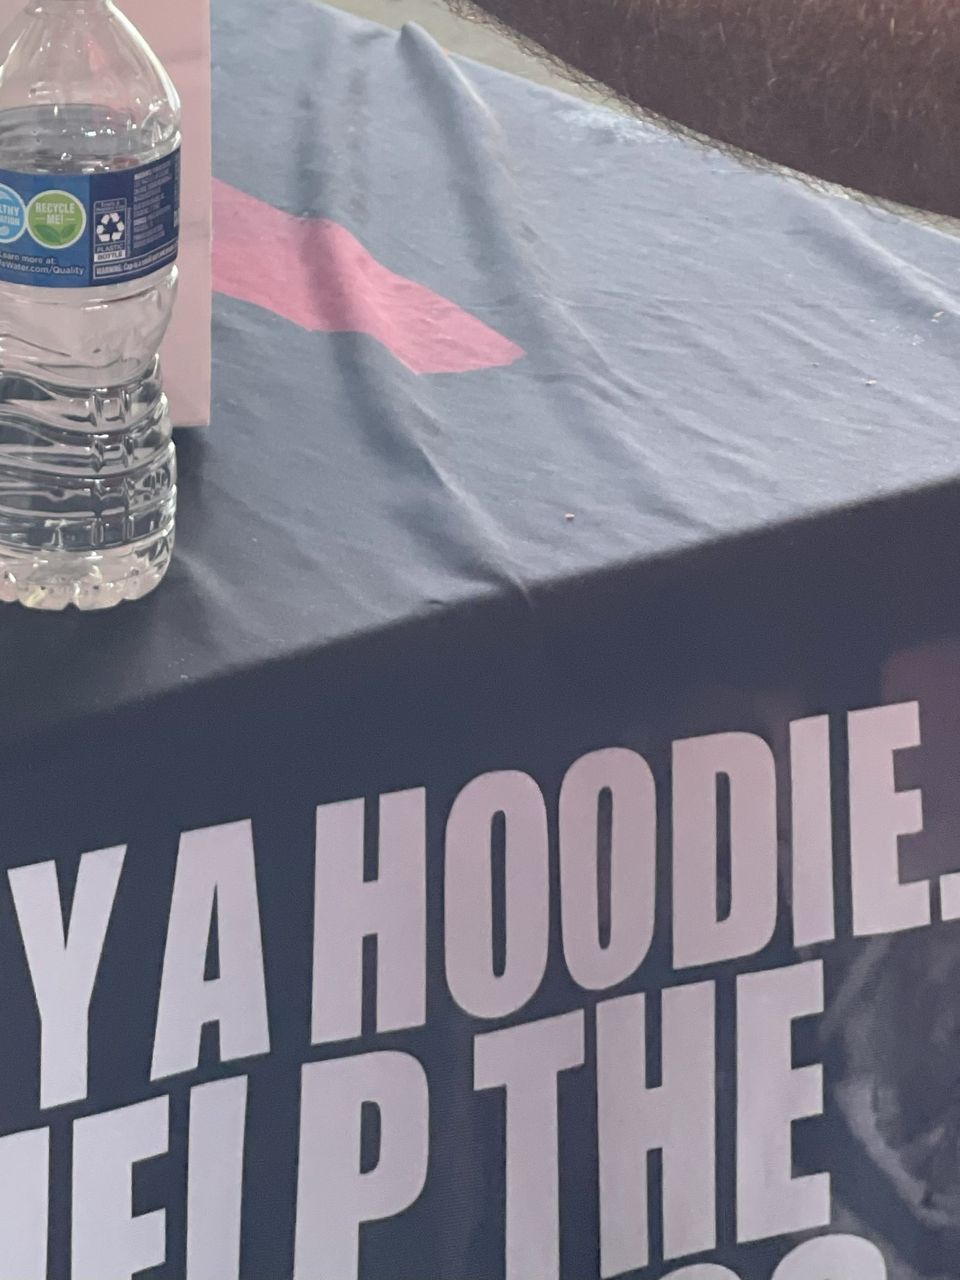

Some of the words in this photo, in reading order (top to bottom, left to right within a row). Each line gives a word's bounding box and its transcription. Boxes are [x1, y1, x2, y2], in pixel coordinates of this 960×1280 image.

[35, 202, 75, 214] RECYCLE
[46, 214, 64, 225] ME!
[21, 255, 43, 264] more
[97, 251, 123, 261] BOTTLE
[150, 818, 271, 1082] A
[473, 958, 832, 1280] THE
